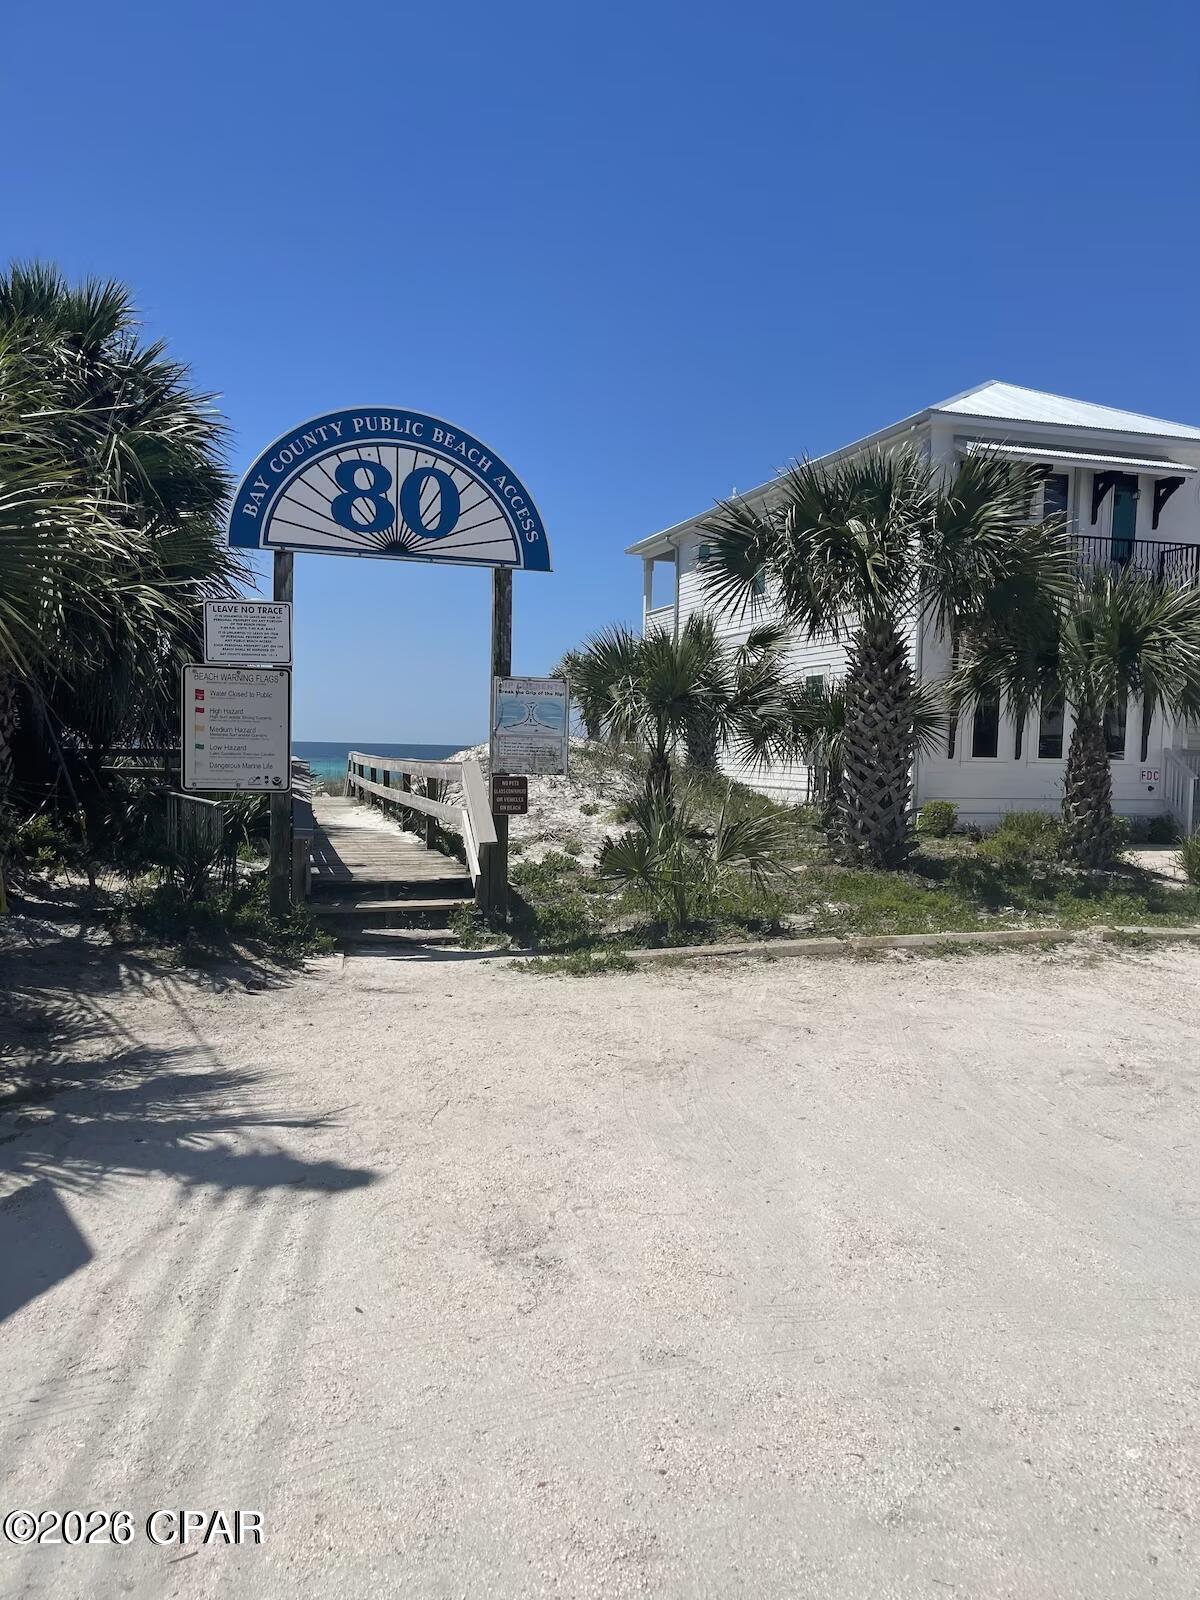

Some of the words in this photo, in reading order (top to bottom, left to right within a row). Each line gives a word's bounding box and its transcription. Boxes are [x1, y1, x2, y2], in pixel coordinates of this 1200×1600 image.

[242, 475, 270, 518] BAY
[270, 421, 344, 472] COUNTY
[352, 416, 424, 437] PUBLIC
[432, 427, 493, 473] BEACH
[493, 474, 539, 543] ACCESS
[331, 459, 460, 539] 80
[221, 673, 254, 682] WARNING
[256, 675, 279, 683] FLAGS
[210, 708, 221, 716] High
[1141, 771, 1159, 780] FDC
